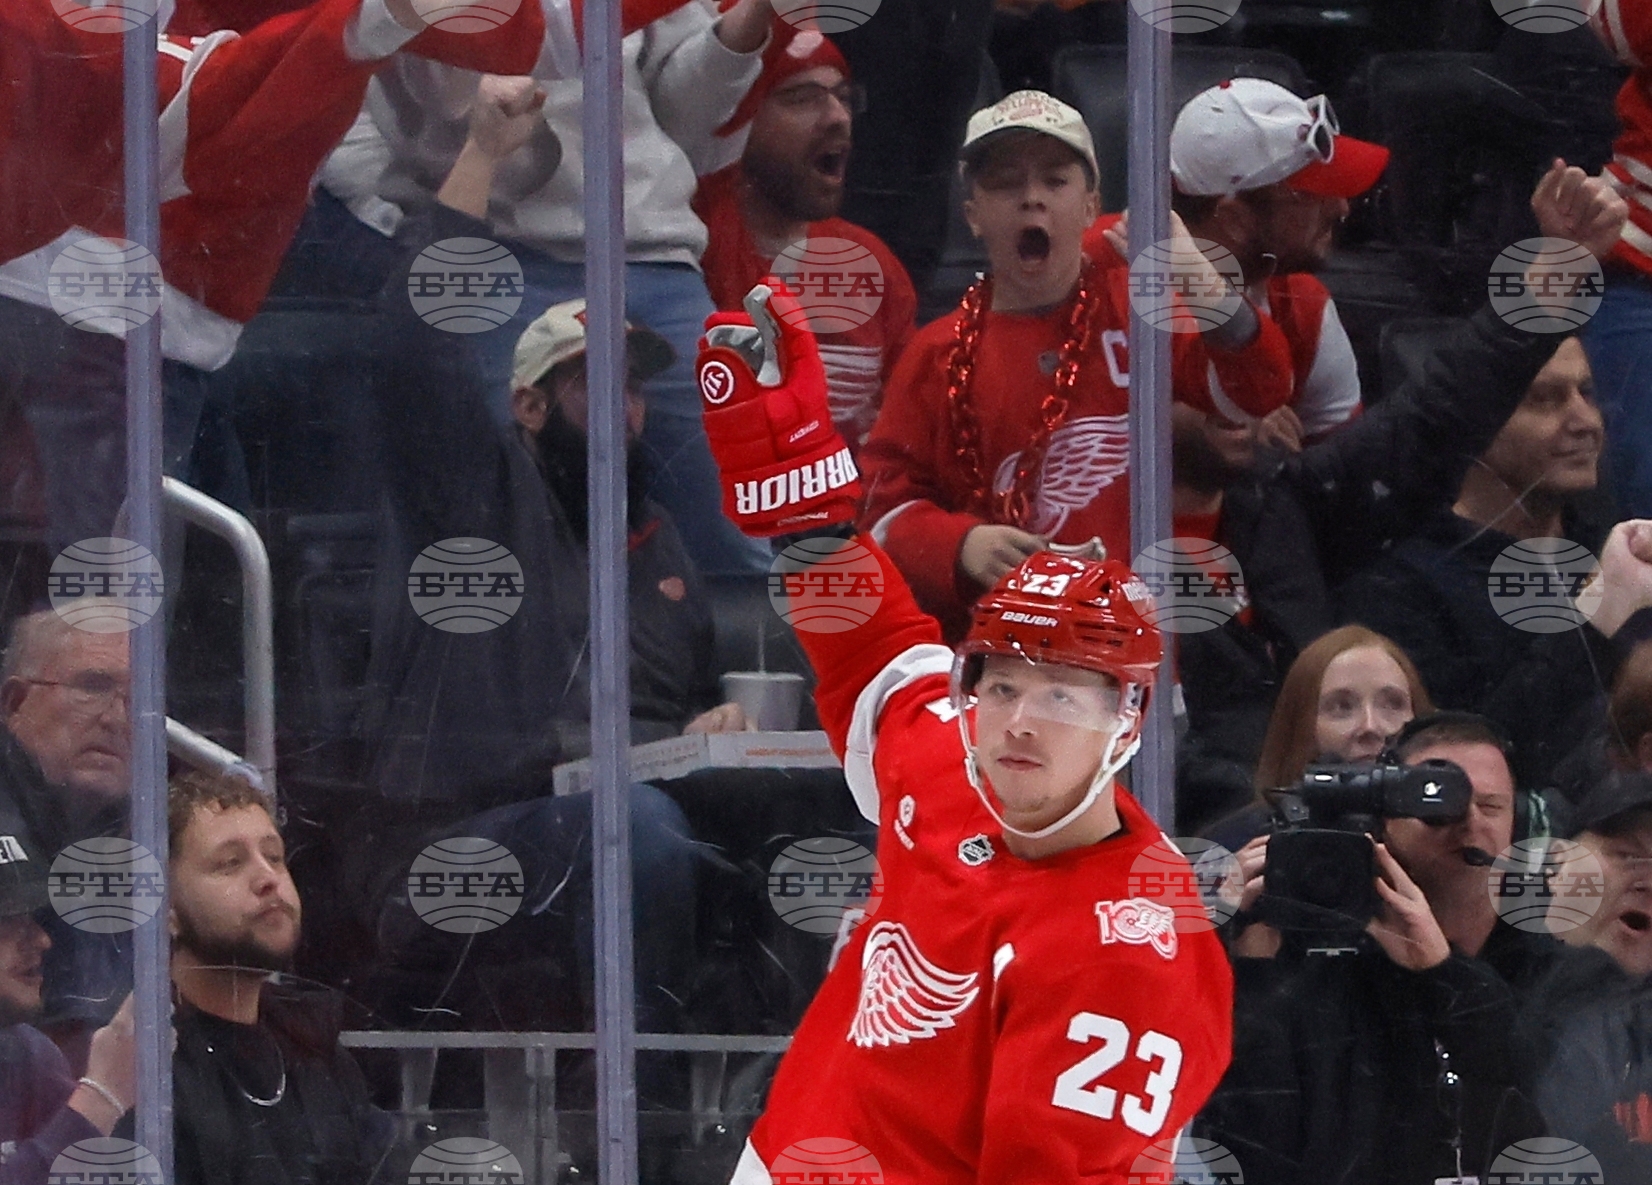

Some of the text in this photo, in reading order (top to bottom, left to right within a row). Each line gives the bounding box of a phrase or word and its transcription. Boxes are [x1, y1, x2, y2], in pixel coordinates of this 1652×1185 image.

[734, 446, 859, 515] ARRIOR
[1021, 573, 1071, 598] 23
[1051, 1011, 1183, 1138] 23
